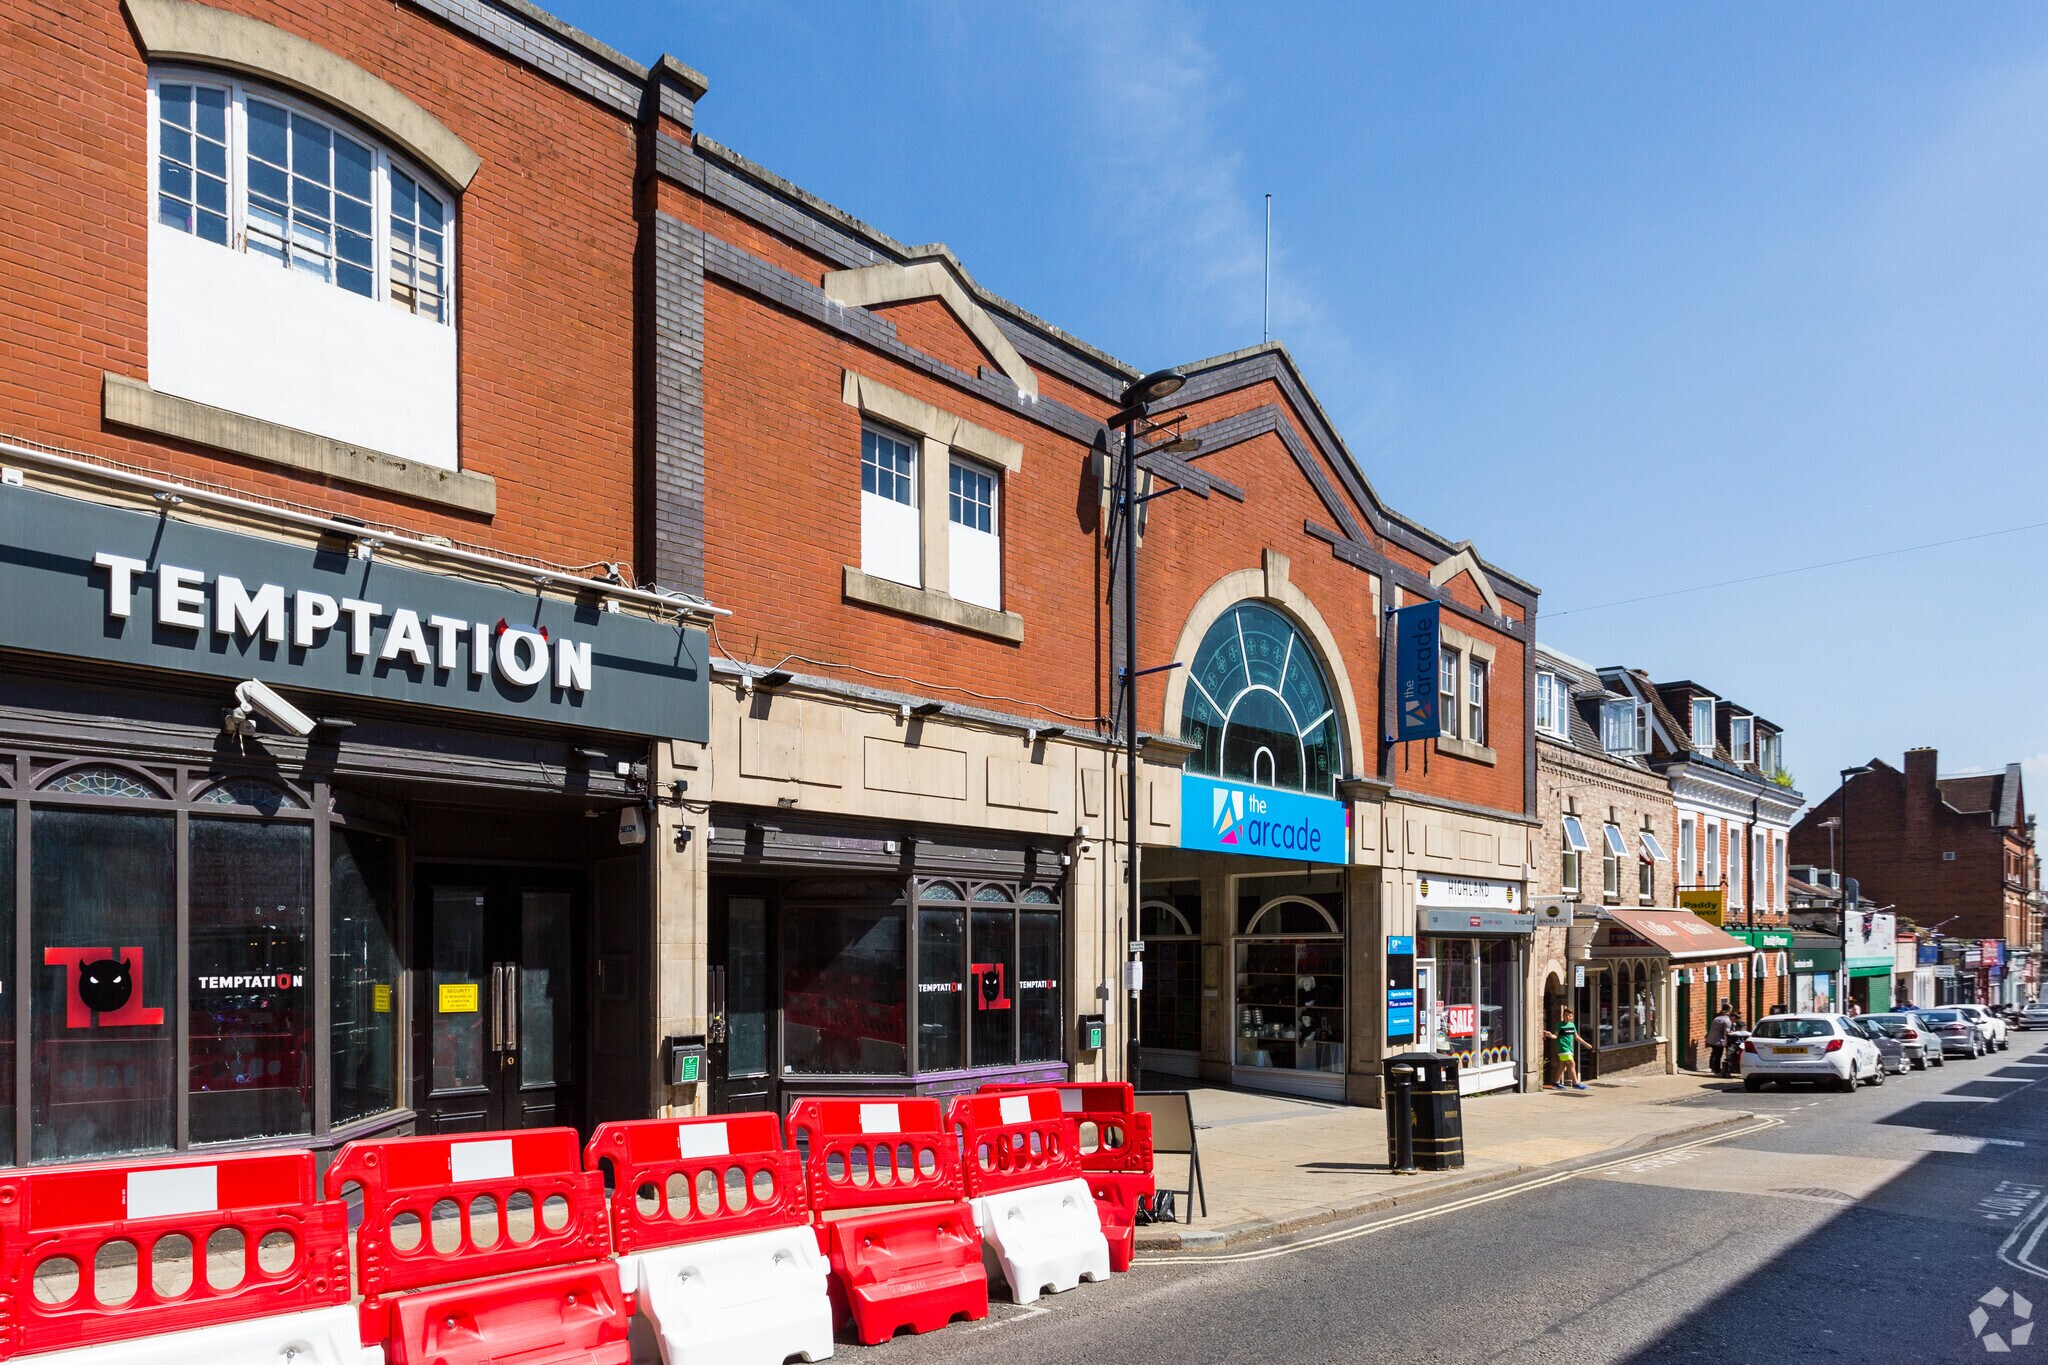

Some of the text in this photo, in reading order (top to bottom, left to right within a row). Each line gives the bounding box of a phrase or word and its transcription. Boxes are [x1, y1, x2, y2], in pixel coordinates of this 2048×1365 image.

[94, 552, 592, 691] TEMPTATION
[1404, 618, 1432, 698] the arcade
[1249, 794, 1267, 814] the
[1248, 817, 1321, 852] arcade
[1448, 879, 1490, 897] HIGHLAND
[1683, 901, 1718, 910] Paddy
[199, 973, 303, 990] TEMPTATION
[918, 982, 962, 993] TEMPTATION
[1020, 979, 1057, 989] TEMPTATION
[1450, 1009, 1474, 1034] SALE
